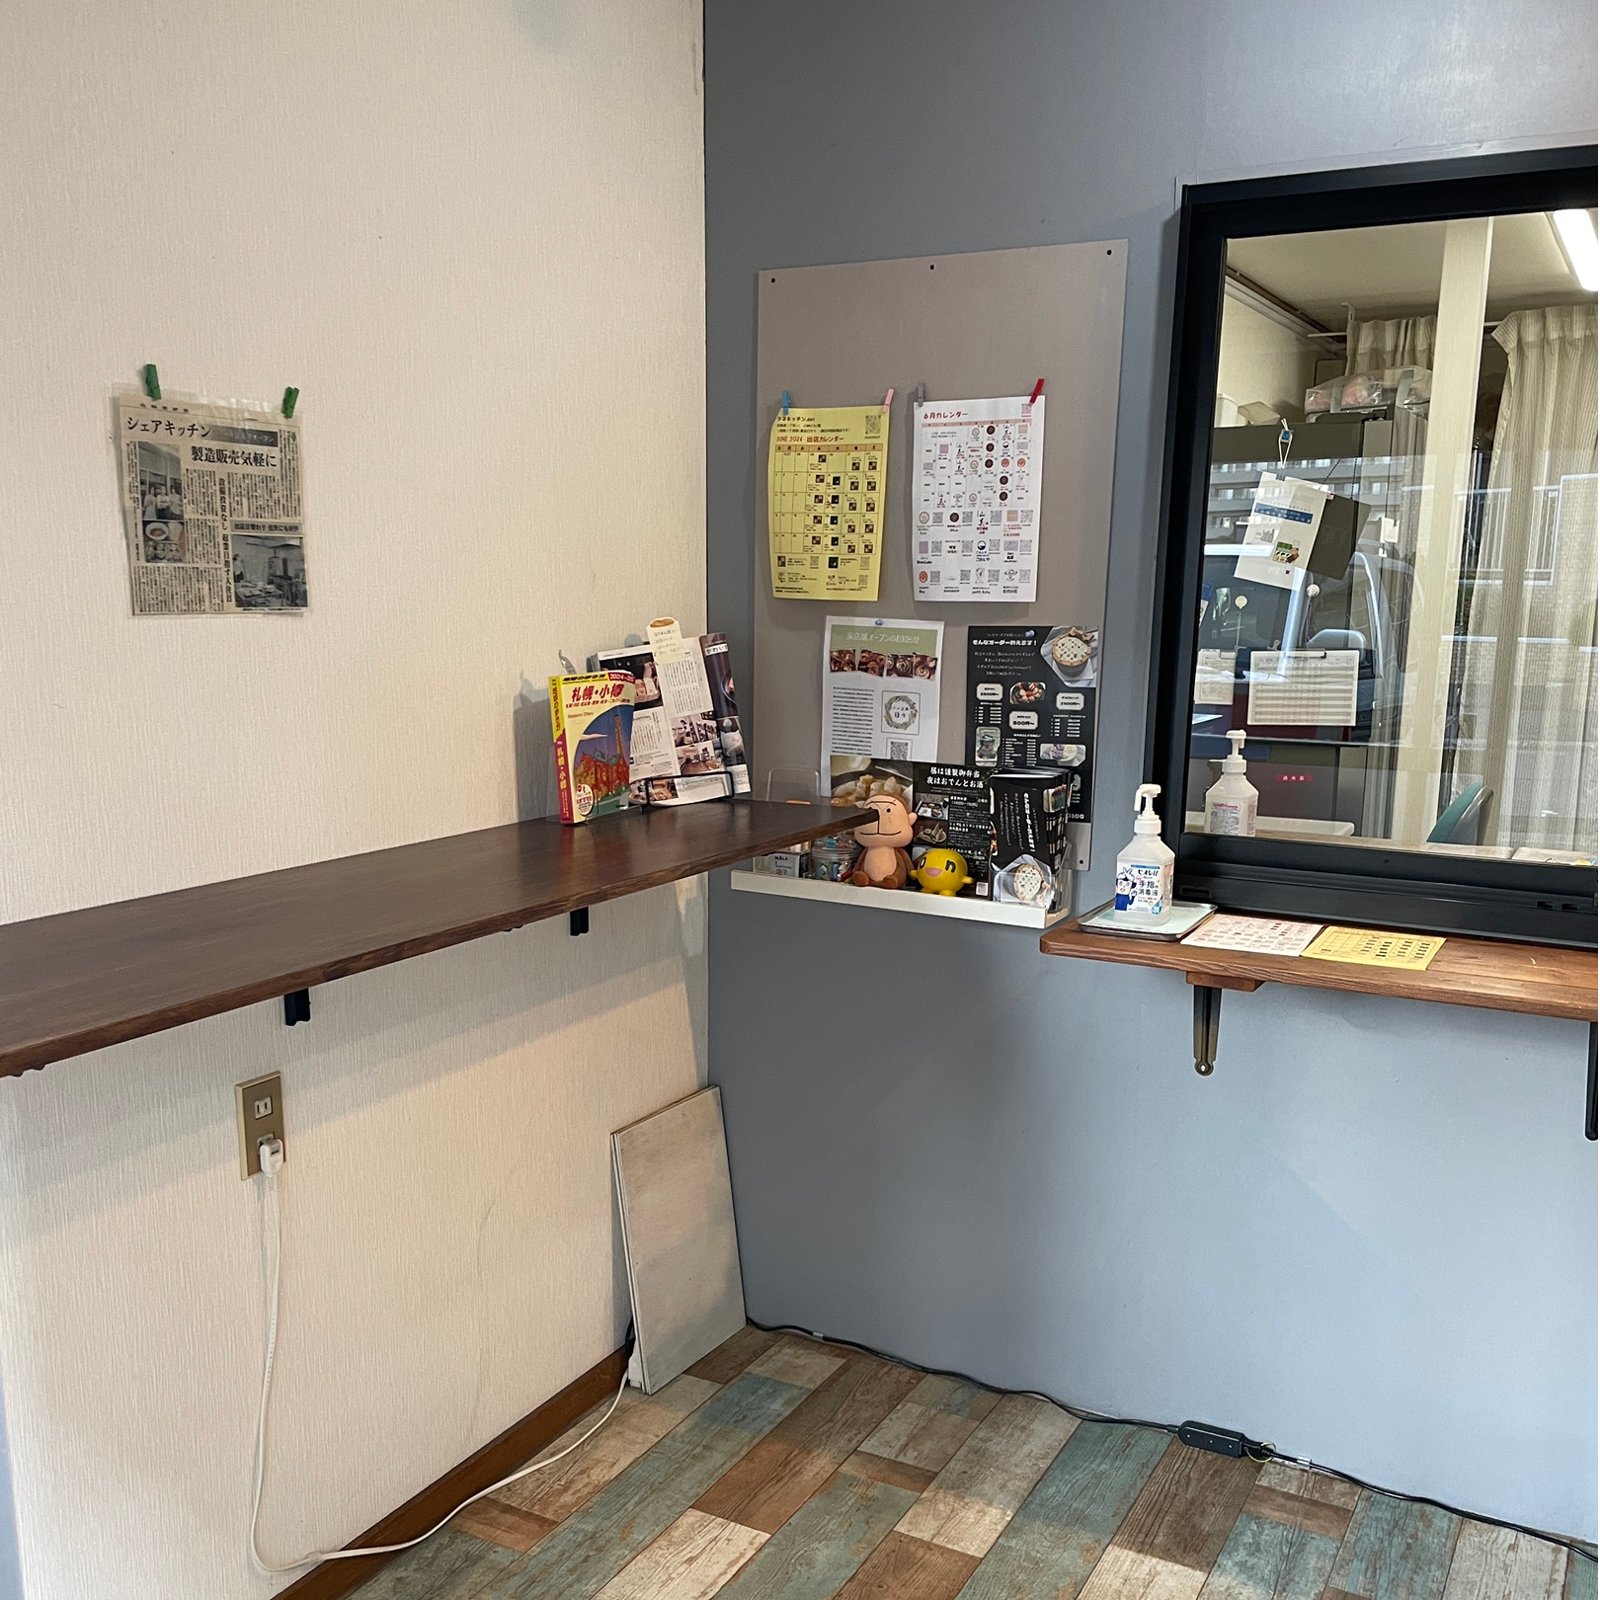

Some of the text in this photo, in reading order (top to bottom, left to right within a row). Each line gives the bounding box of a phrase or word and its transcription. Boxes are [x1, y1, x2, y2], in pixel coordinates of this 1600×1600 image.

[923, 411, 968, 420] 6月カレンダー
[127, 416, 212, 438] シェアキッチン
[191, 445, 278, 468] 製造販売気軽に
